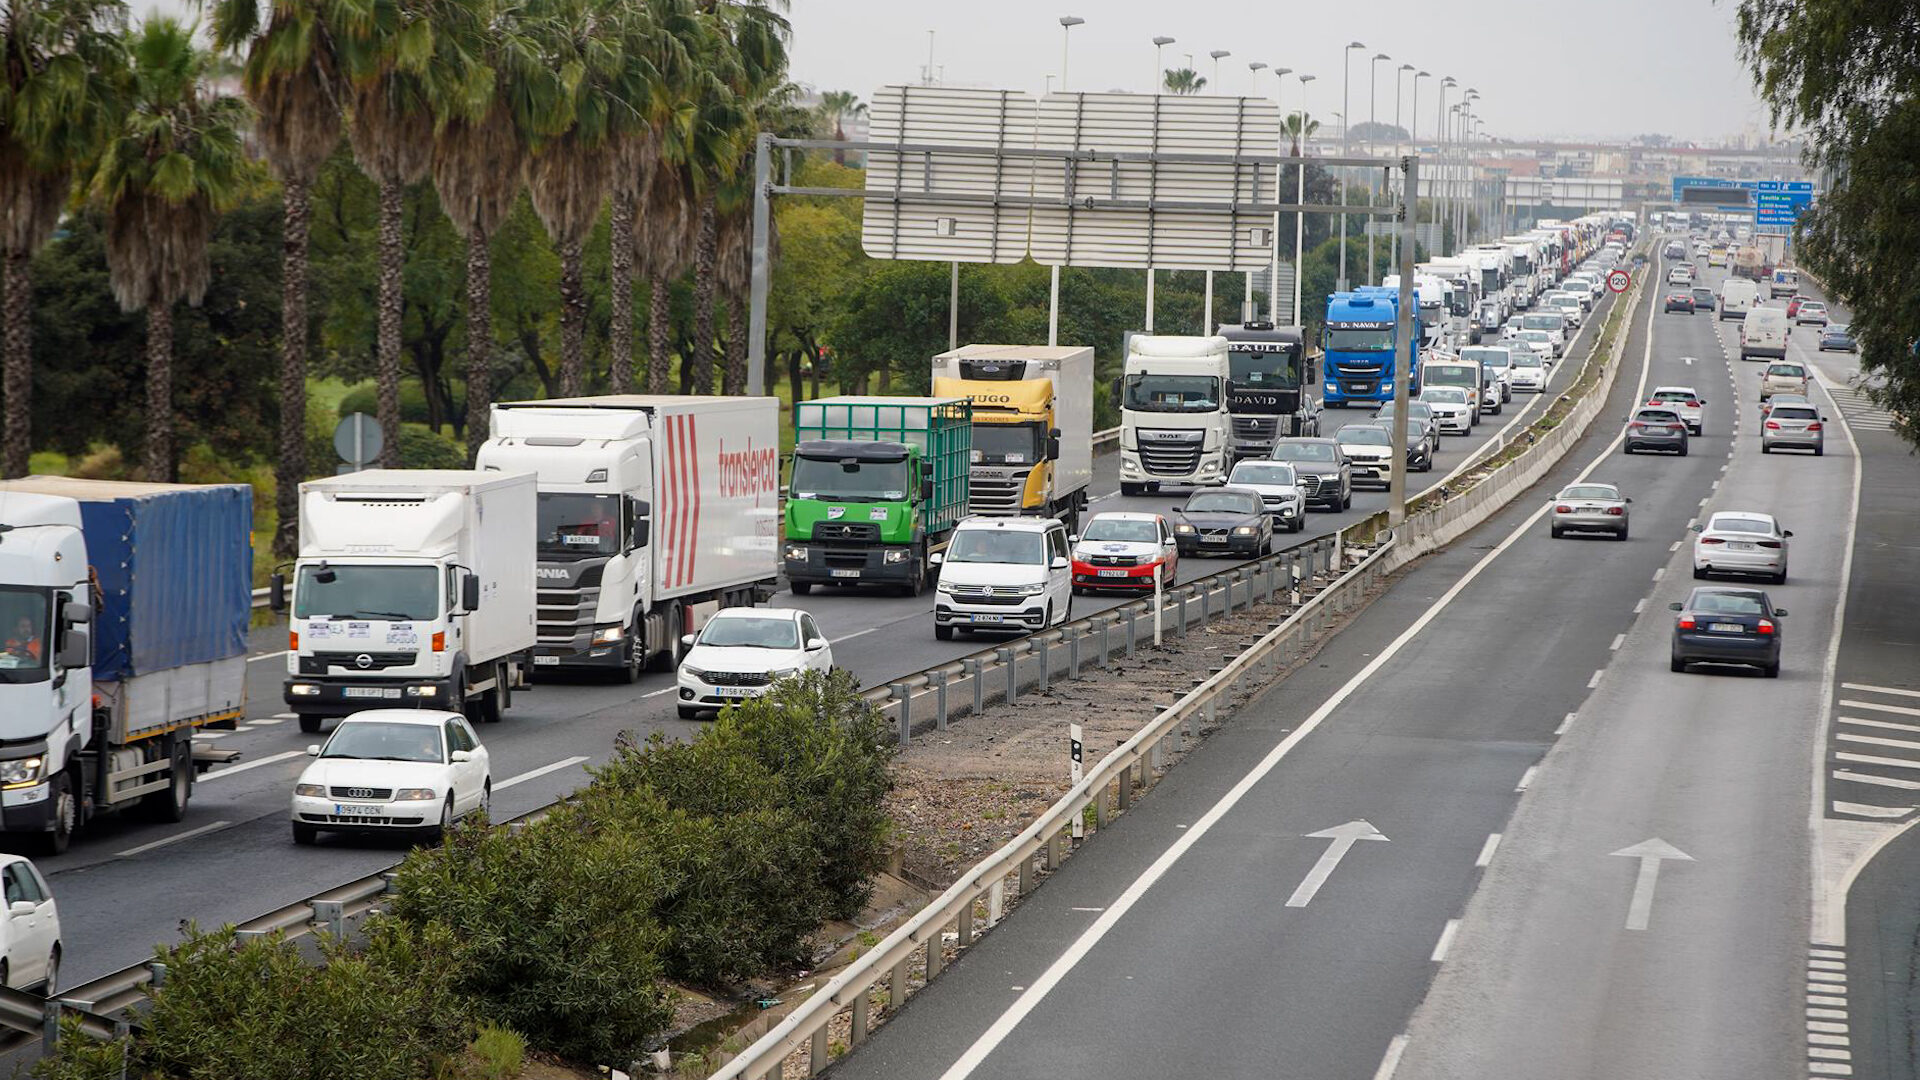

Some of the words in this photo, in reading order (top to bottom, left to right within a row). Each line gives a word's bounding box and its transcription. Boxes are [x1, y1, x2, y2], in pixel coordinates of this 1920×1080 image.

[1611, 277, 1627, 286] 120
[1234, 395, 1277, 405] DAVID
[537, 568, 570, 579] ANIA
